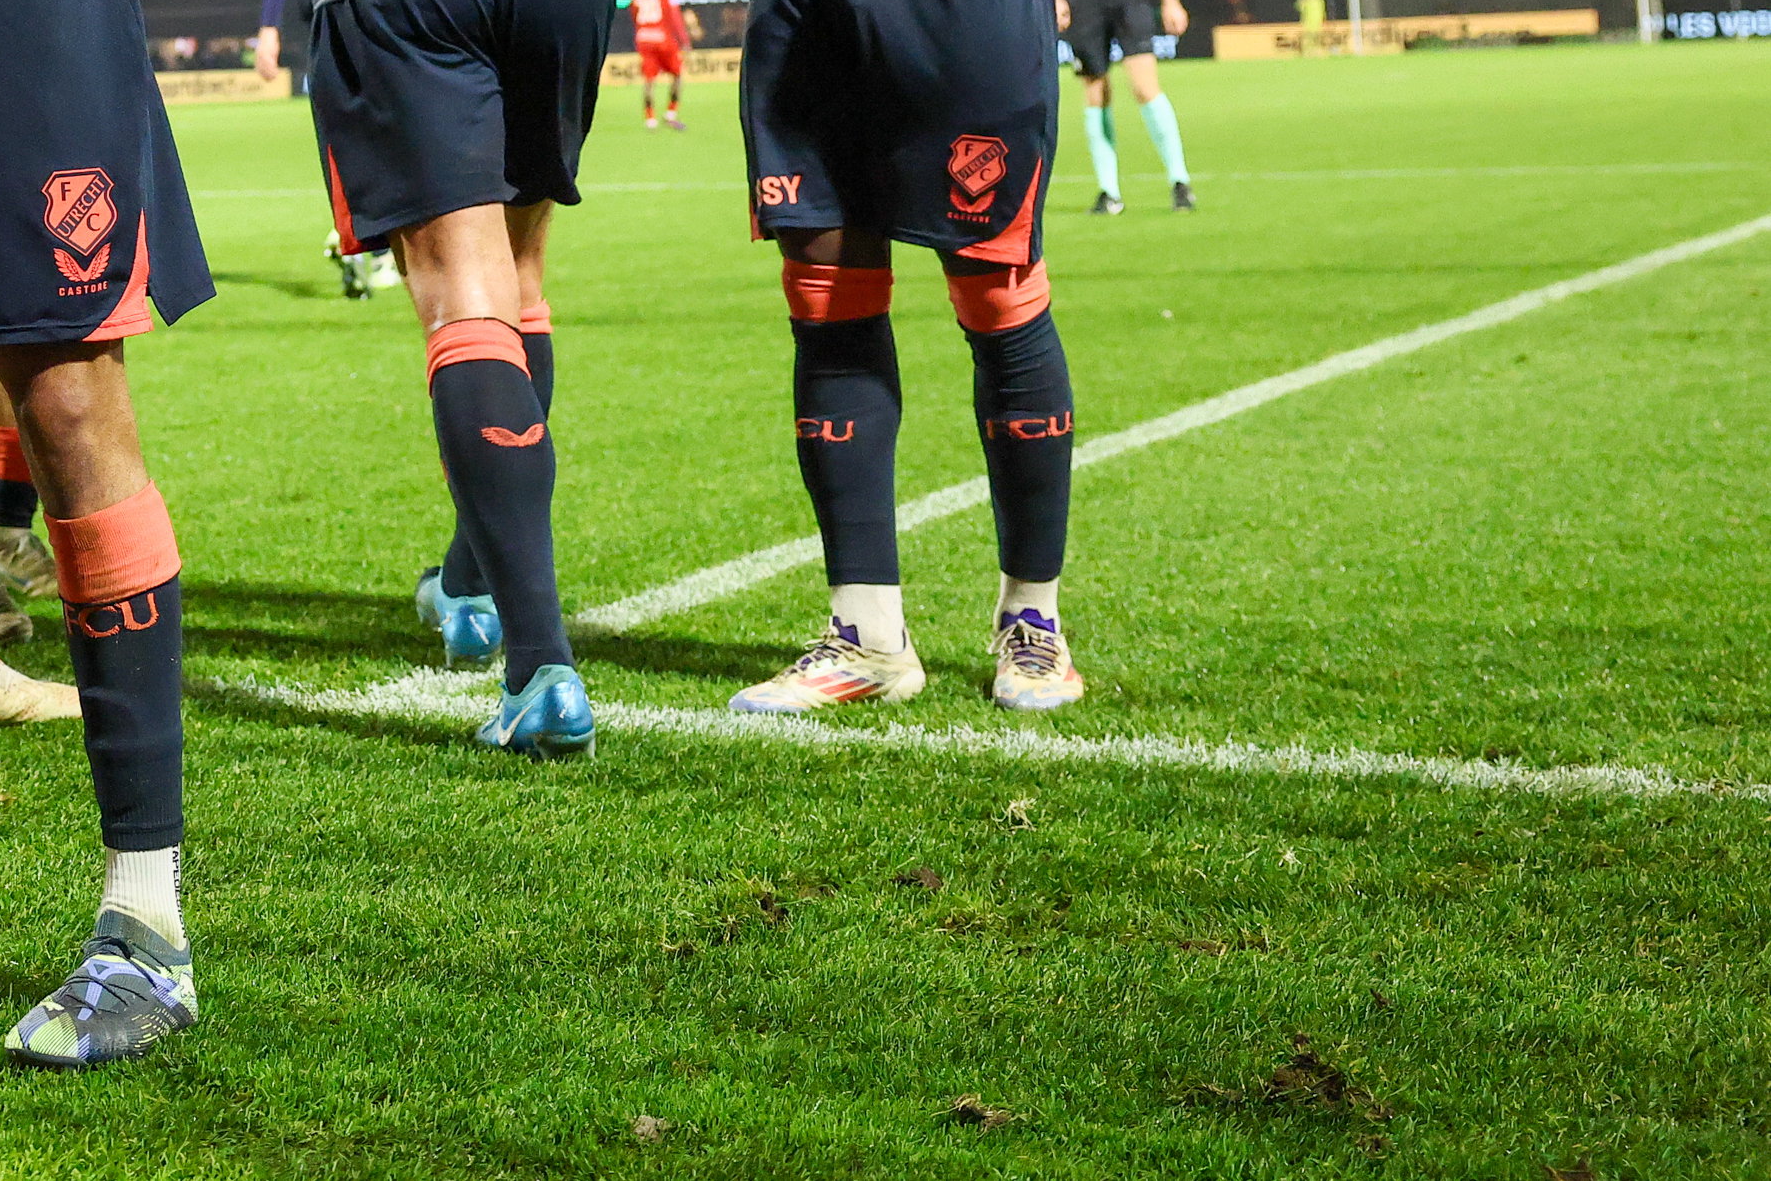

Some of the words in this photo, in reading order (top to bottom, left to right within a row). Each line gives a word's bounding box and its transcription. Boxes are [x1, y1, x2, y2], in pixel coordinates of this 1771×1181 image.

[61, 182, 72, 201] F
[57, 176, 105, 237] UTRECHT
[86, 213, 101, 231] C
[58, 281, 108, 296] CASTORE
[64, 593, 160, 638] FCU
